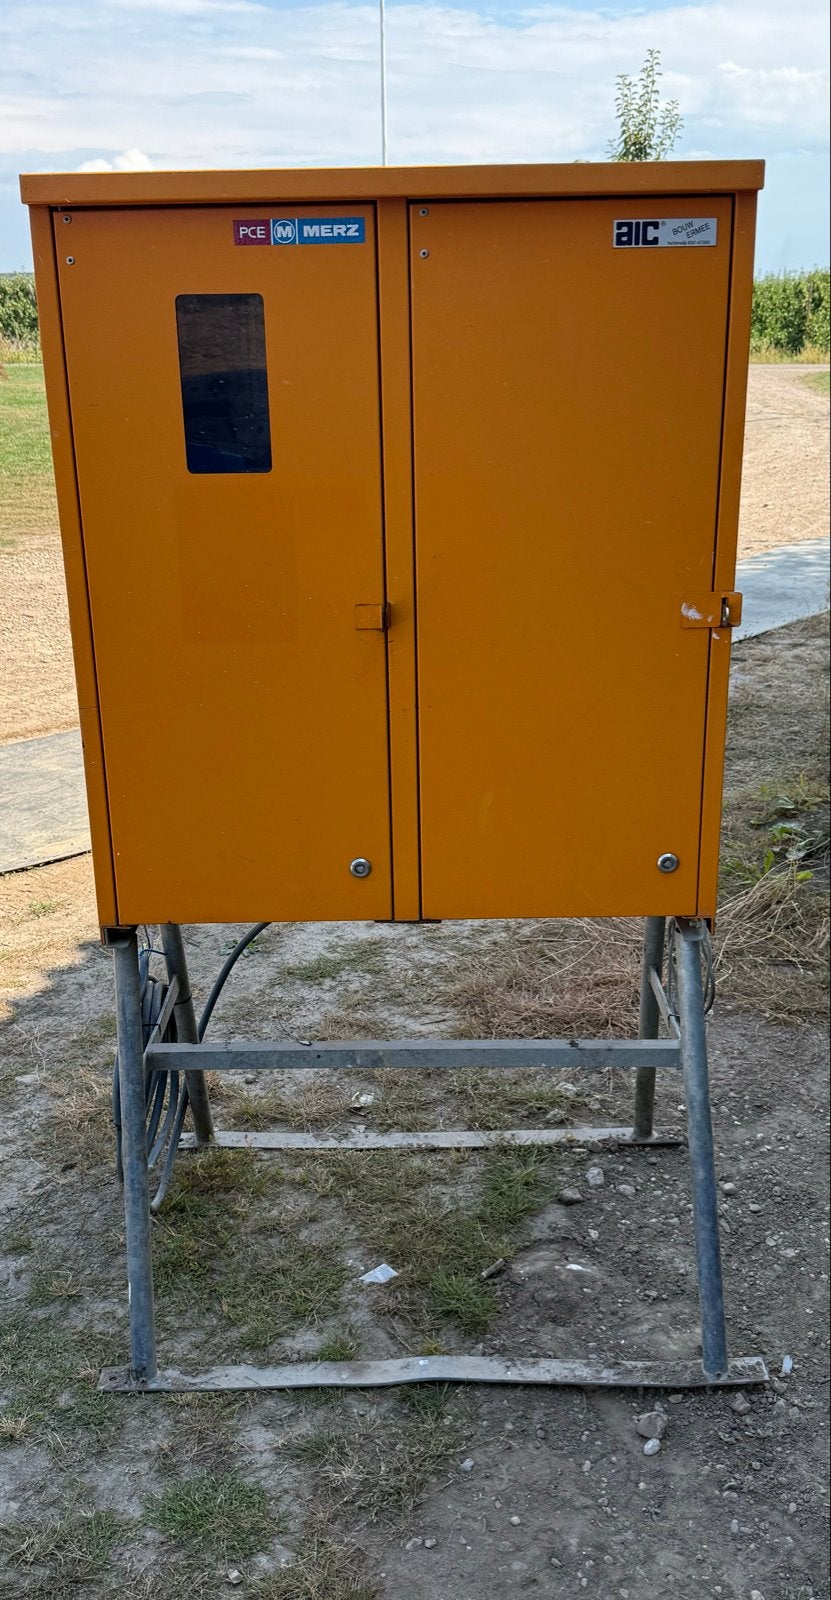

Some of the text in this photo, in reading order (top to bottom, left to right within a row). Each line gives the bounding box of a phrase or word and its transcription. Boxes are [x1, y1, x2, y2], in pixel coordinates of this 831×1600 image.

[239, 224, 360, 239] PCE M MERZ
[671, 220, 694, 236] BOUW
[685, 222, 711, 239] ERMEE
